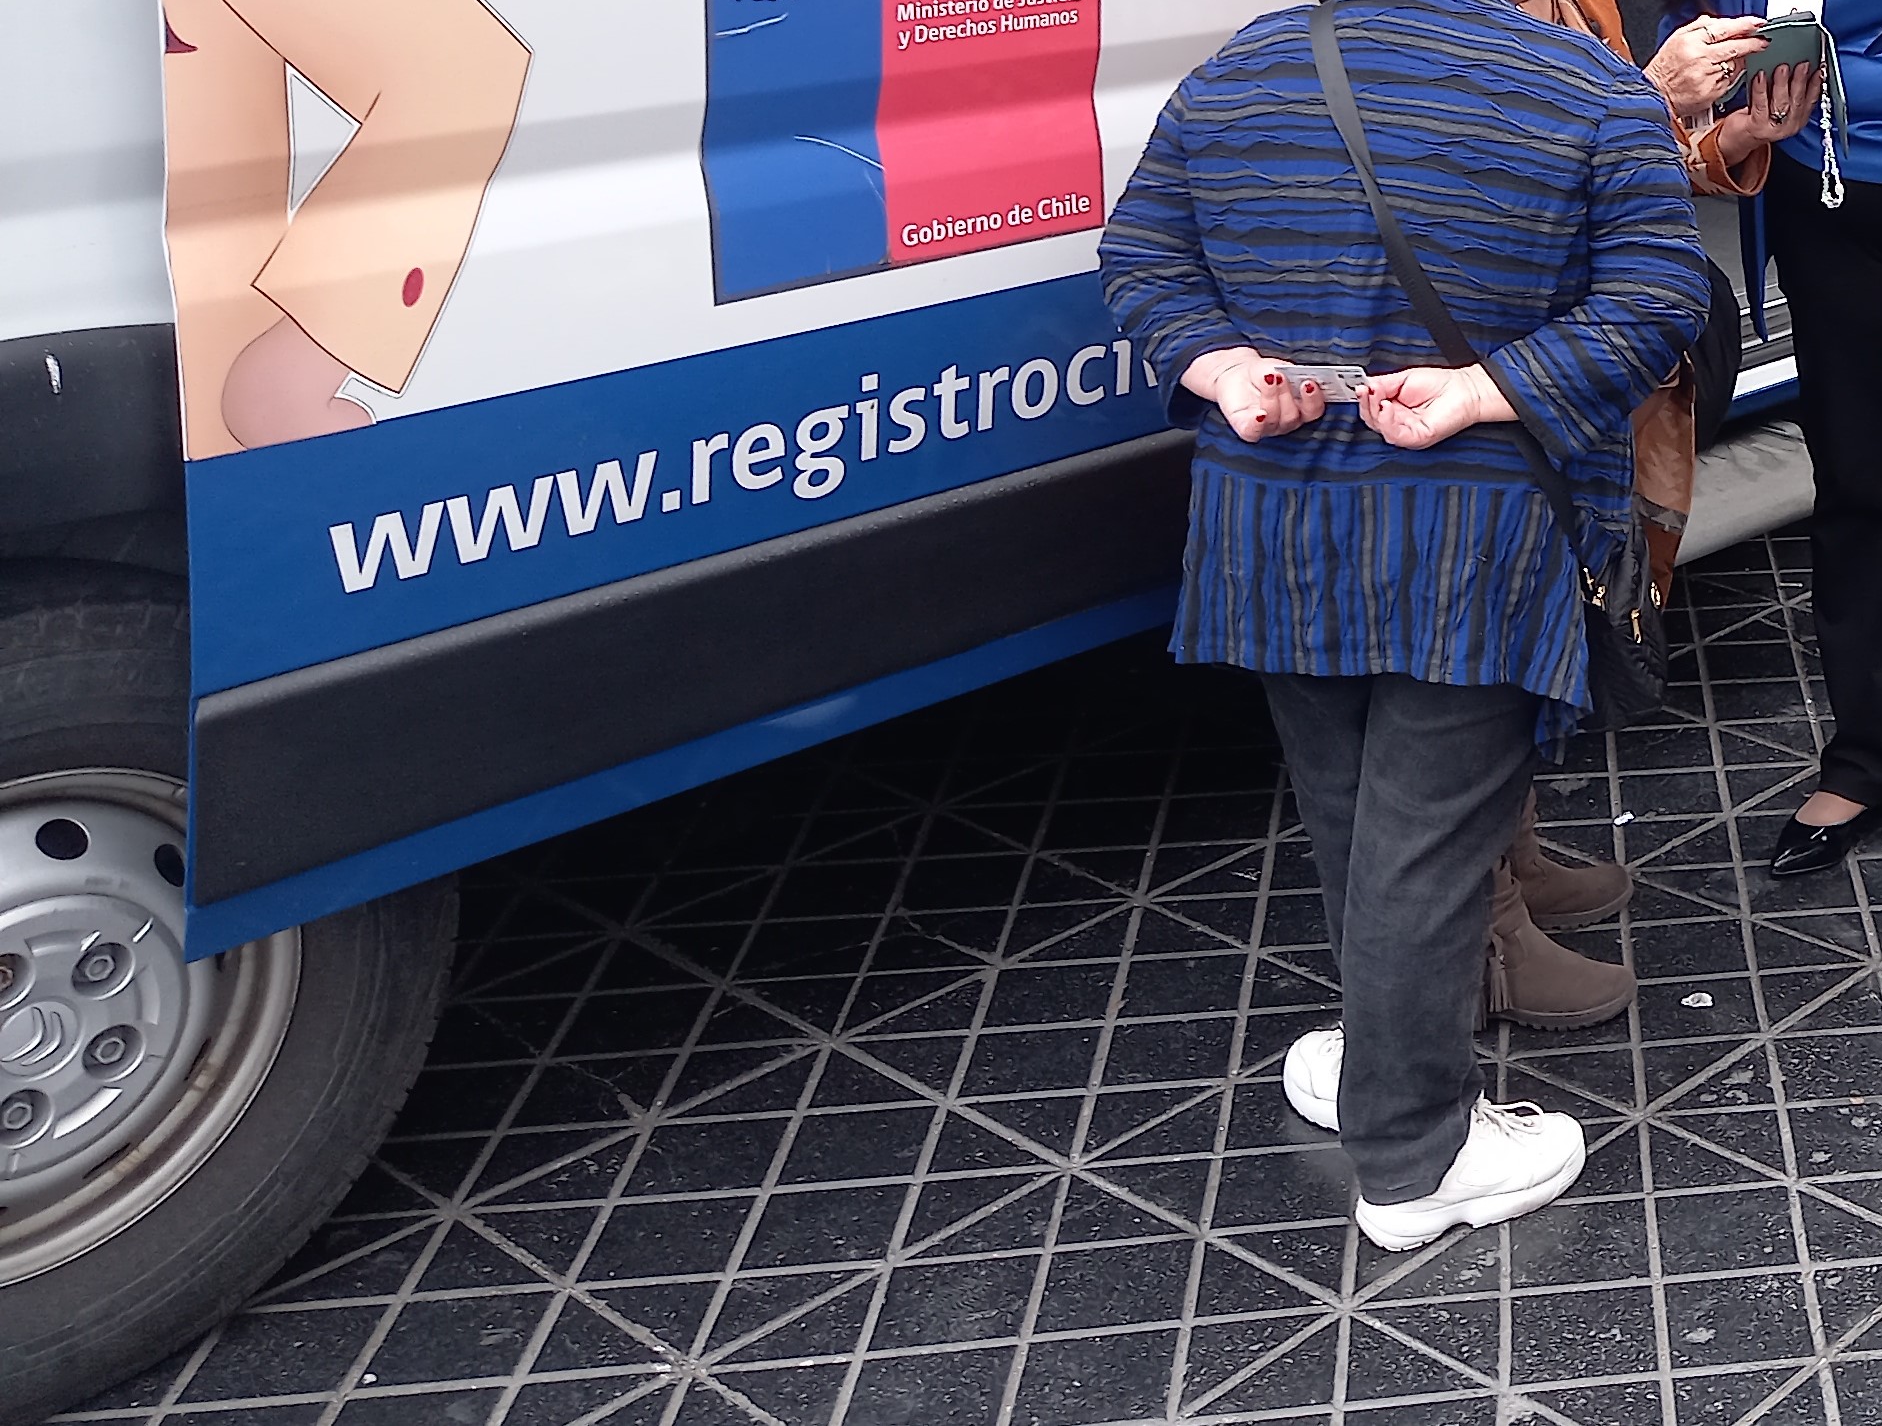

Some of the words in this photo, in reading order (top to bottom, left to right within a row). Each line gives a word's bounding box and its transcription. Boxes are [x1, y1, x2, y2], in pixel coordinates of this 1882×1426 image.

[897, 29, 911, 50] y
[914, 16, 997, 45] Derechos
[999, 7, 1079, 35] Humanos
[901, 213, 1003, 248] Gobierno
[1007, 205, 1033, 229] de
[1037, 192, 1091, 221] Chile
